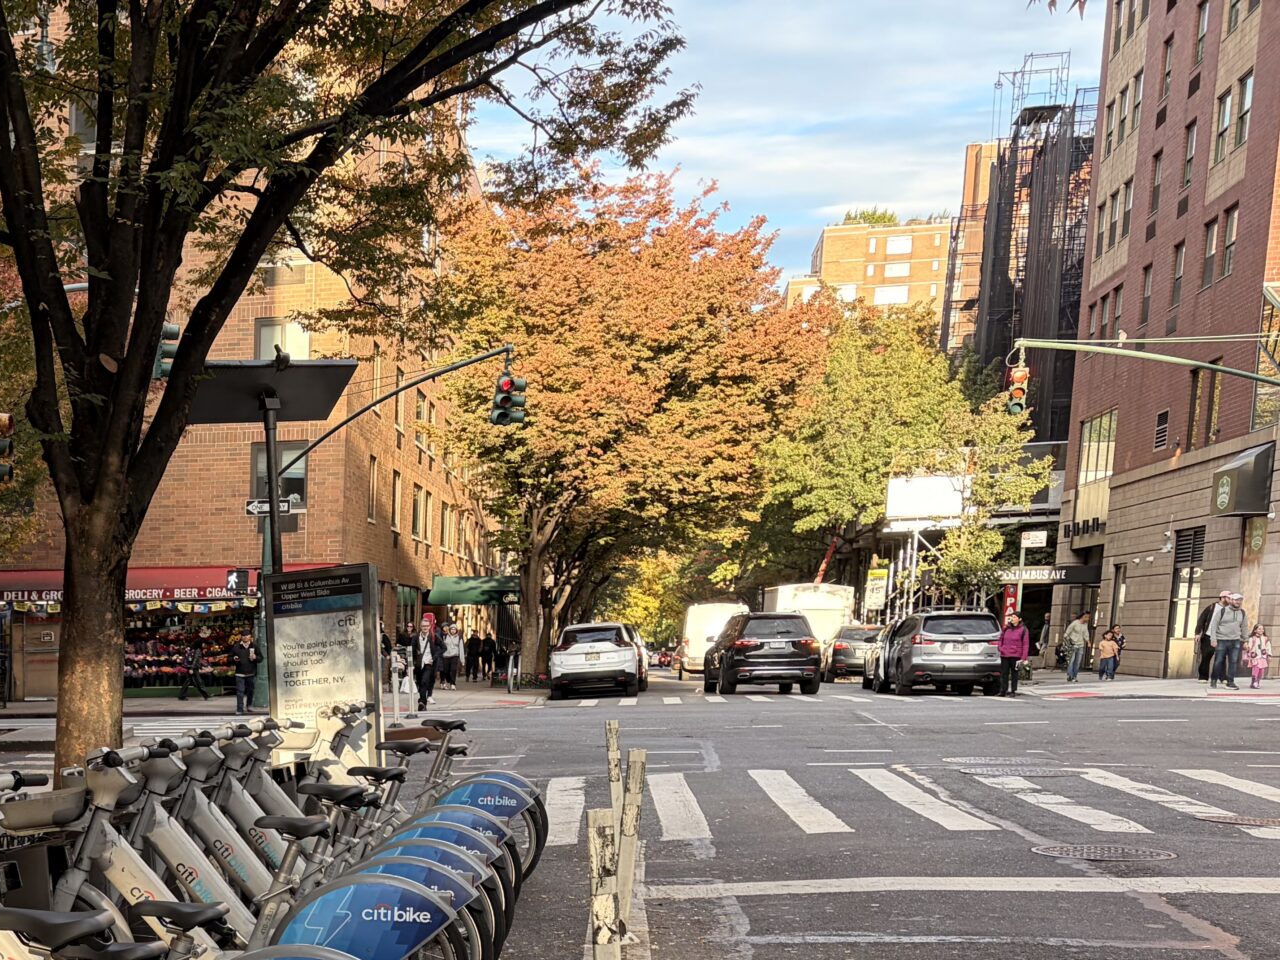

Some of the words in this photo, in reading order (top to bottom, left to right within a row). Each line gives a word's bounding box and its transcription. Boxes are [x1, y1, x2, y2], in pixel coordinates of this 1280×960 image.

[1050, 570, 1067, 579] AVE
[310, 579, 340, 587] Columbus
[4, 591, 28, 600] DELI
[30, 591, 39, 600] &
[124, 588, 164, 599] GROCERY
[174, 588, 198, 598] BEER
[338, 615, 356, 627] citi
[283, 642, 305, 650] You're
[307, 640, 327, 650] going
[283, 670, 300, 679] GET
[283, 677, 331, 687] TOGETHER,
[495, 796, 517, 807] bike
[213, 839, 232, 860] citi
[175, 863, 196, 884] citi
[362, 903, 391, 921] citi
[394, 906, 431, 923] bike
